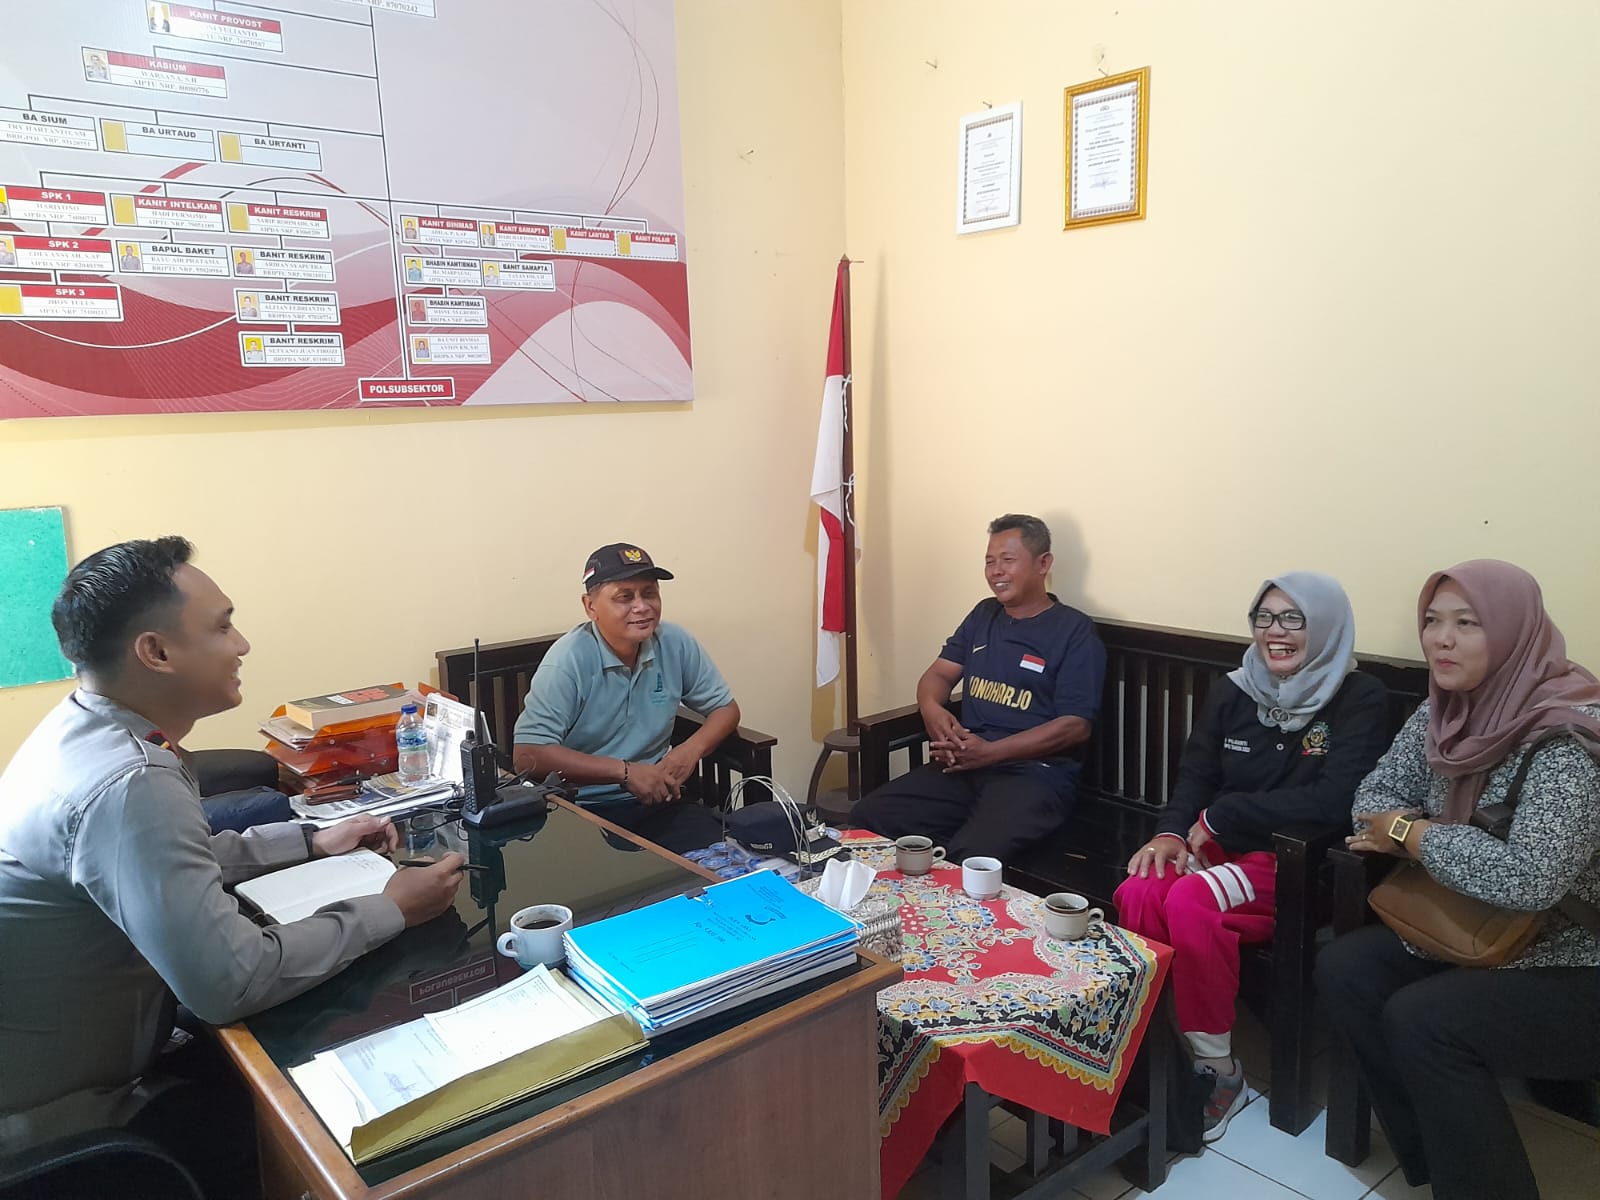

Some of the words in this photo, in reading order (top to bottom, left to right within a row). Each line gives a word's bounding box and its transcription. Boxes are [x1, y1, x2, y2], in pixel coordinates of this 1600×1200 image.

[189, 9, 219, 21] KANIT
[220, 15, 263, 28] PROVOST
[149, 60, 188, 72] KASIUM
[22, 113, 38, 122] BA
[40, 115, 68, 125] SIUM
[141, 125, 157, 135] BA
[158, 127, 197, 139] URTAUD
[254, 137, 267, 146] BA
[268, 139, 306, 150] URTANTI
[41, 191, 63, 200] SPK
[65, 192, 72, 201] 1
[138, 198, 168, 208] KANIT
[170, 200, 218, 211] INTELKAM
[254, 206, 281, 216] KANIT
[283, 208, 321, 218] RESKRIM
[421, 219, 445, 227] KANIT
[48, 240, 69, 248] SPK
[72, 241, 79, 249] 2
[151, 245, 183, 254] BAPUL
[185, 246, 216, 256] BAKET
[260, 251, 286, 259] BANIT
[288, 252, 326, 261] RESKRIM
[502, 263, 521, 271] BANIT
[521, 264, 549, 272] SAMAPTA
[55, 288, 76, 296] SPK
[265, 294, 290, 302] BANIT
[292, 295, 330, 304] RESKRIM
[270, 337, 296, 345] BANIT
[297, 338, 335, 346] RESKRIM
[369, 384, 445, 394] POLSUBSEKTOR
